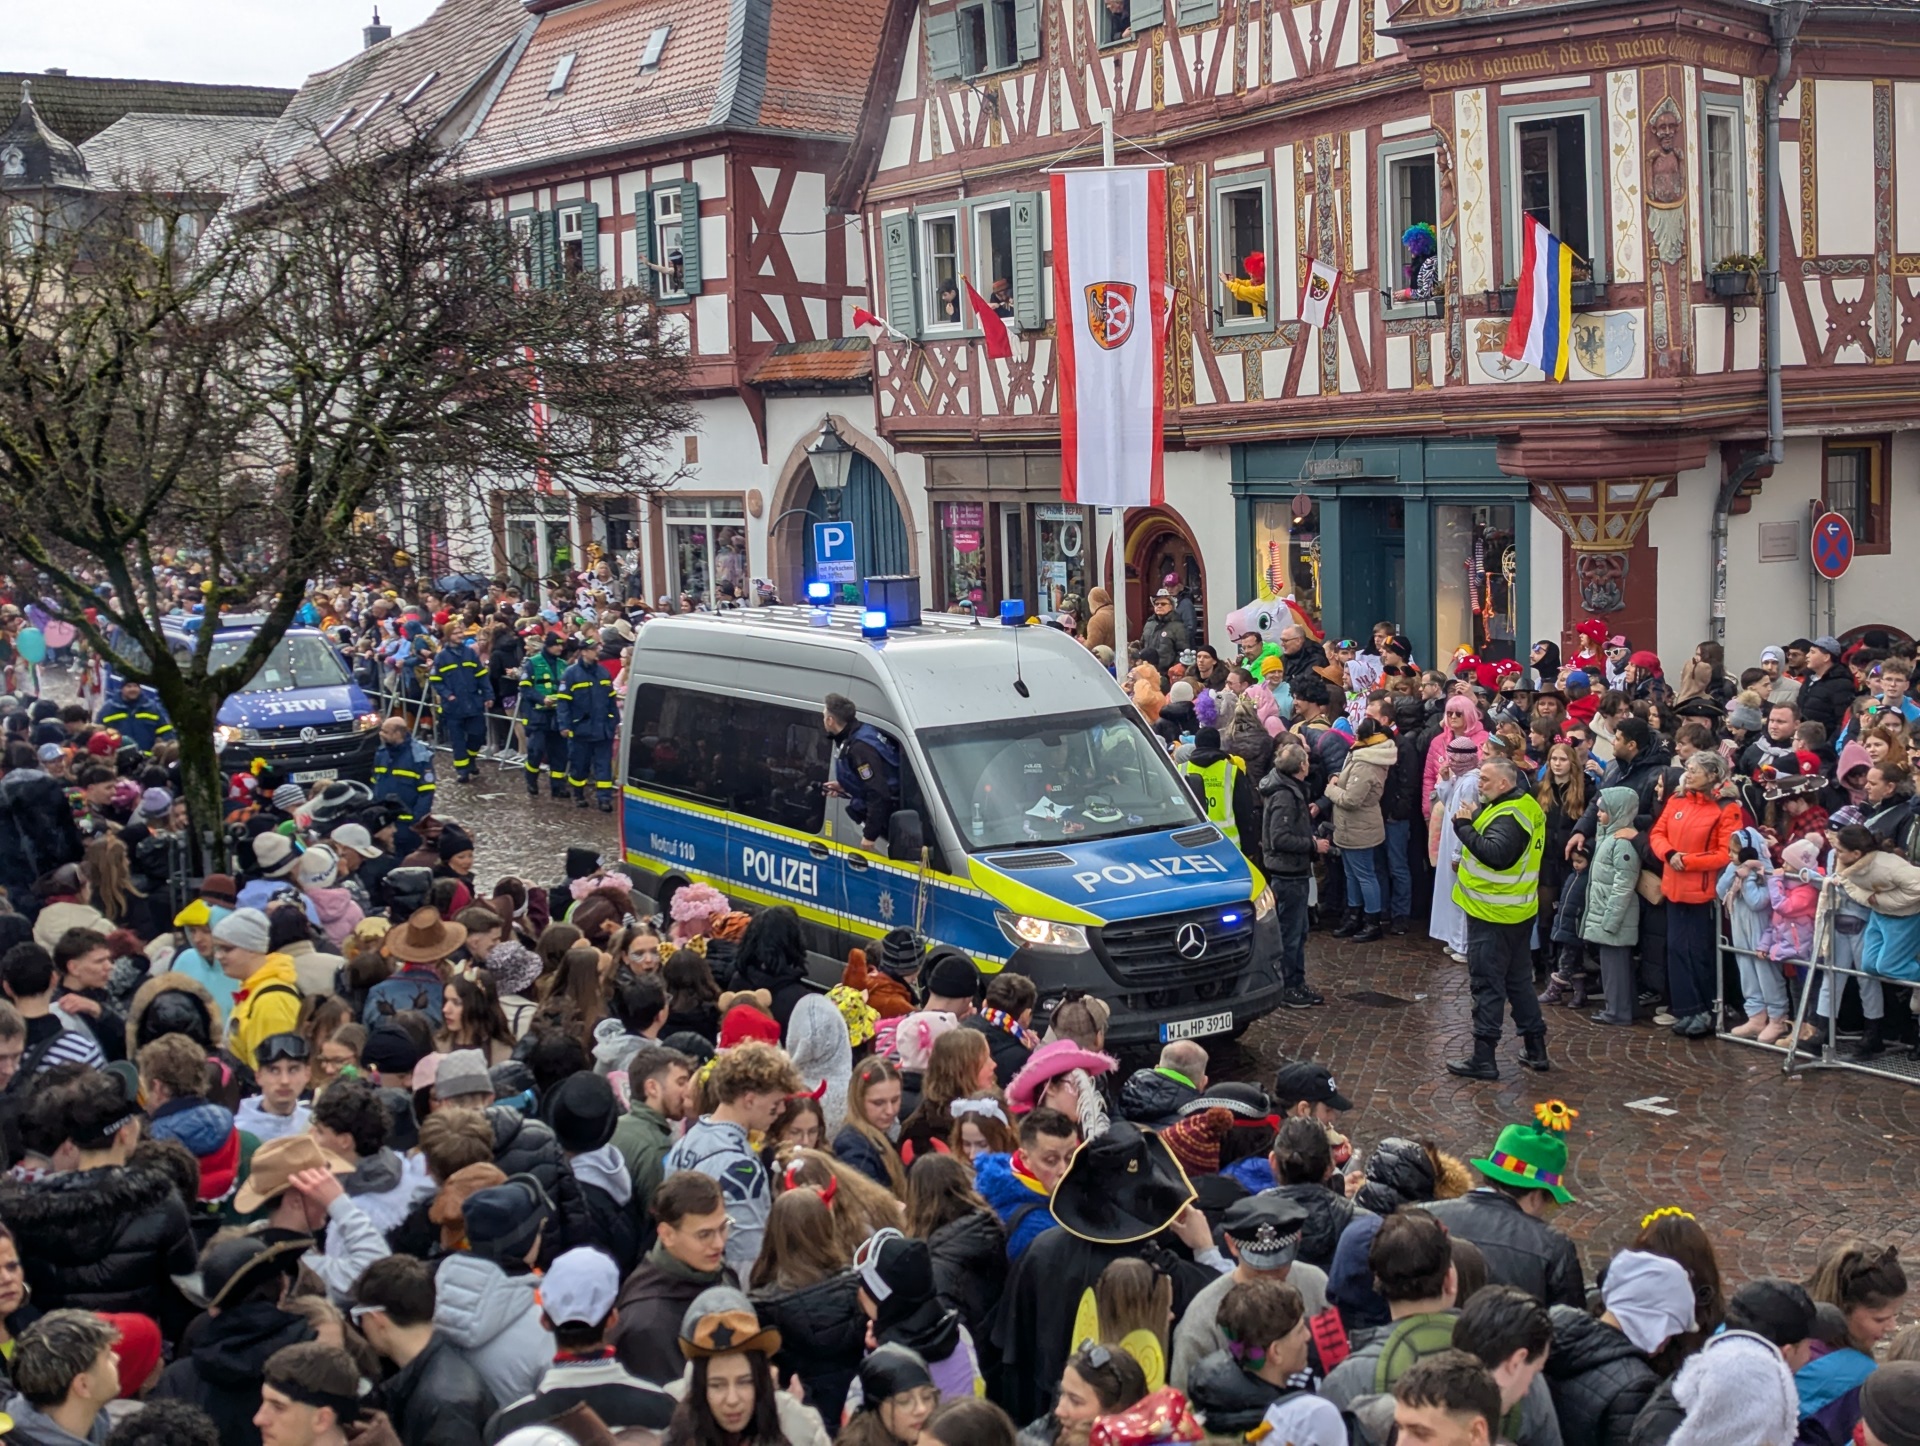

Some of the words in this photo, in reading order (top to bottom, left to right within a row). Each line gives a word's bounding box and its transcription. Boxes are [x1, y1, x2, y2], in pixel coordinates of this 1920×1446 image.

[1423, 58, 1475, 89] Stadt
[1483, 50, 1555, 81] genannt,
[1587, 43, 1610, 67] ich
[1616, 36, 1667, 60] meine
[824, 528, 844, 557] P
[264, 699, 327, 716] THW
[650, 833, 677, 856] Notruf
[679, 840, 695, 861] 110
[743, 847, 818, 896] POLIZEI
[1072, 854, 1228, 893] POLIZEI
[1168, 1023, 1182, 1039] WI
[1190, 1020, 1204, 1035] HP
[1206, 1014, 1231, 1032] 3910
